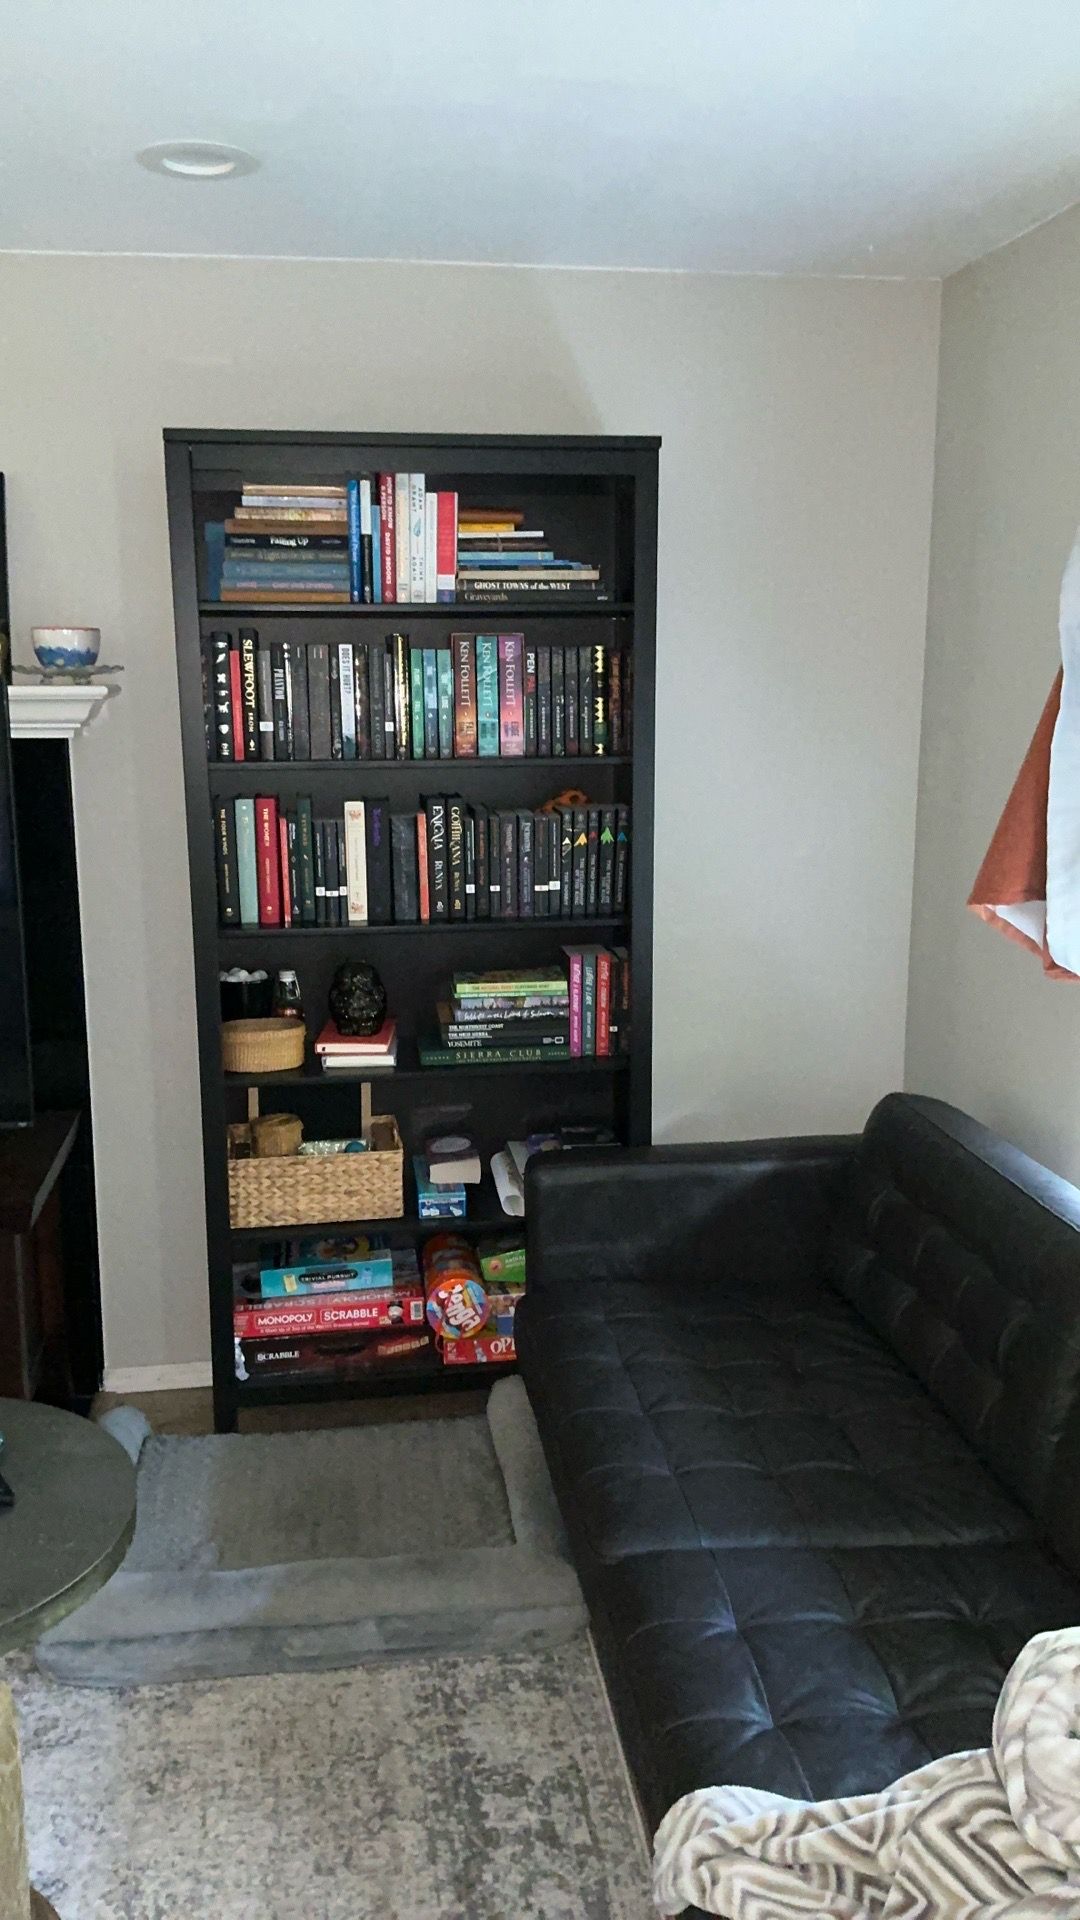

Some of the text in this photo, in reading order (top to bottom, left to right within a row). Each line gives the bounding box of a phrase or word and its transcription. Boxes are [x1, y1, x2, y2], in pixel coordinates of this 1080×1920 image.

[387, 496, 392, 505] TO
[270, 537, 309, 546] Falling Up
[474, 582, 500, 590] GHOST
[502, 582, 528, 590] TOWNS
[243, 639, 255, 707] SLEWFOOT
[459, 641, 470, 706] KEN FOLLETT
[482, 642, 493, 707] KEN FOLLETT
[504, 641, 515, 706] KEN FOLLETT
[526, 652, 535, 673] PEN
[431, 806, 444, 850] ENIGMA
[450, 806, 462, 865] GOTHIKANA
[456, 1051, 500, 1059] SIERRA
[258, 1308, 378, 1325] MONOPOLY SCRABBLE
[438, 1283, 481, 1331] Jenga
[257, 1351, 299, 1360] SCRABBLE
